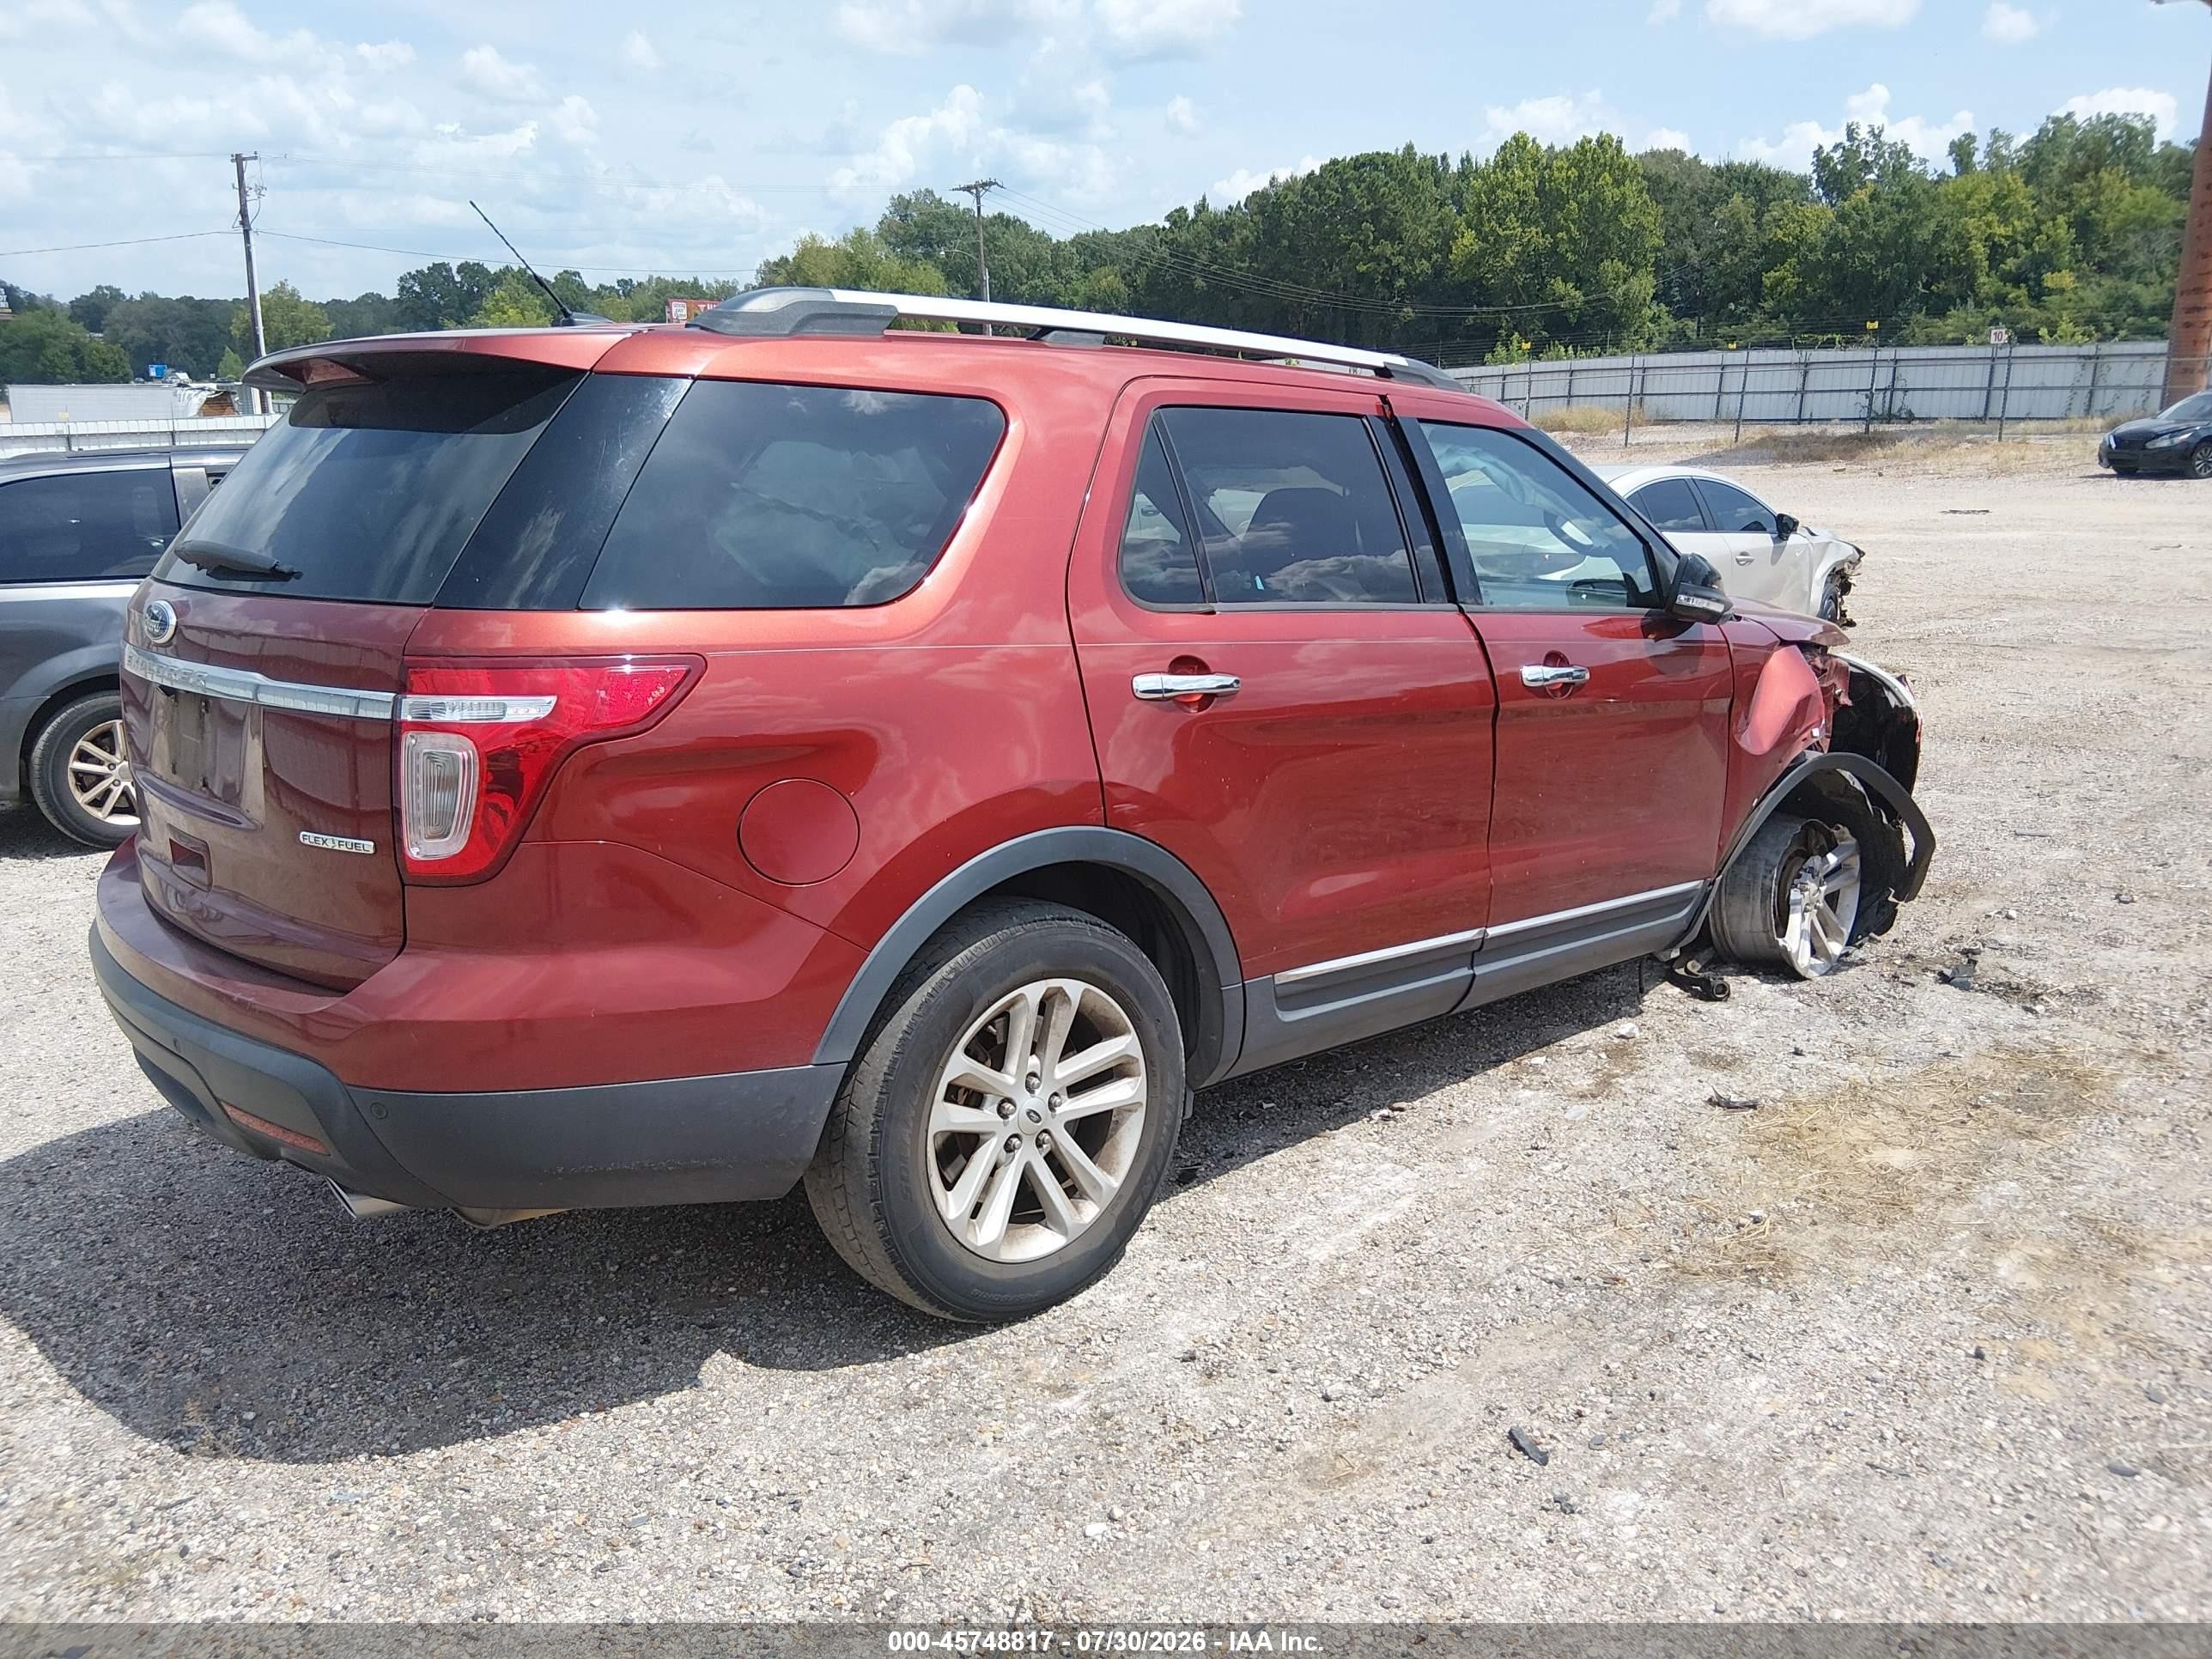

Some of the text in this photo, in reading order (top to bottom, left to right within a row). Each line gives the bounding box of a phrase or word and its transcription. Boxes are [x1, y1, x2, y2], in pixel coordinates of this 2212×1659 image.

[1993, 331, 2003, 342] 10
[301, 833, 370, 852] FLEX FUEL
